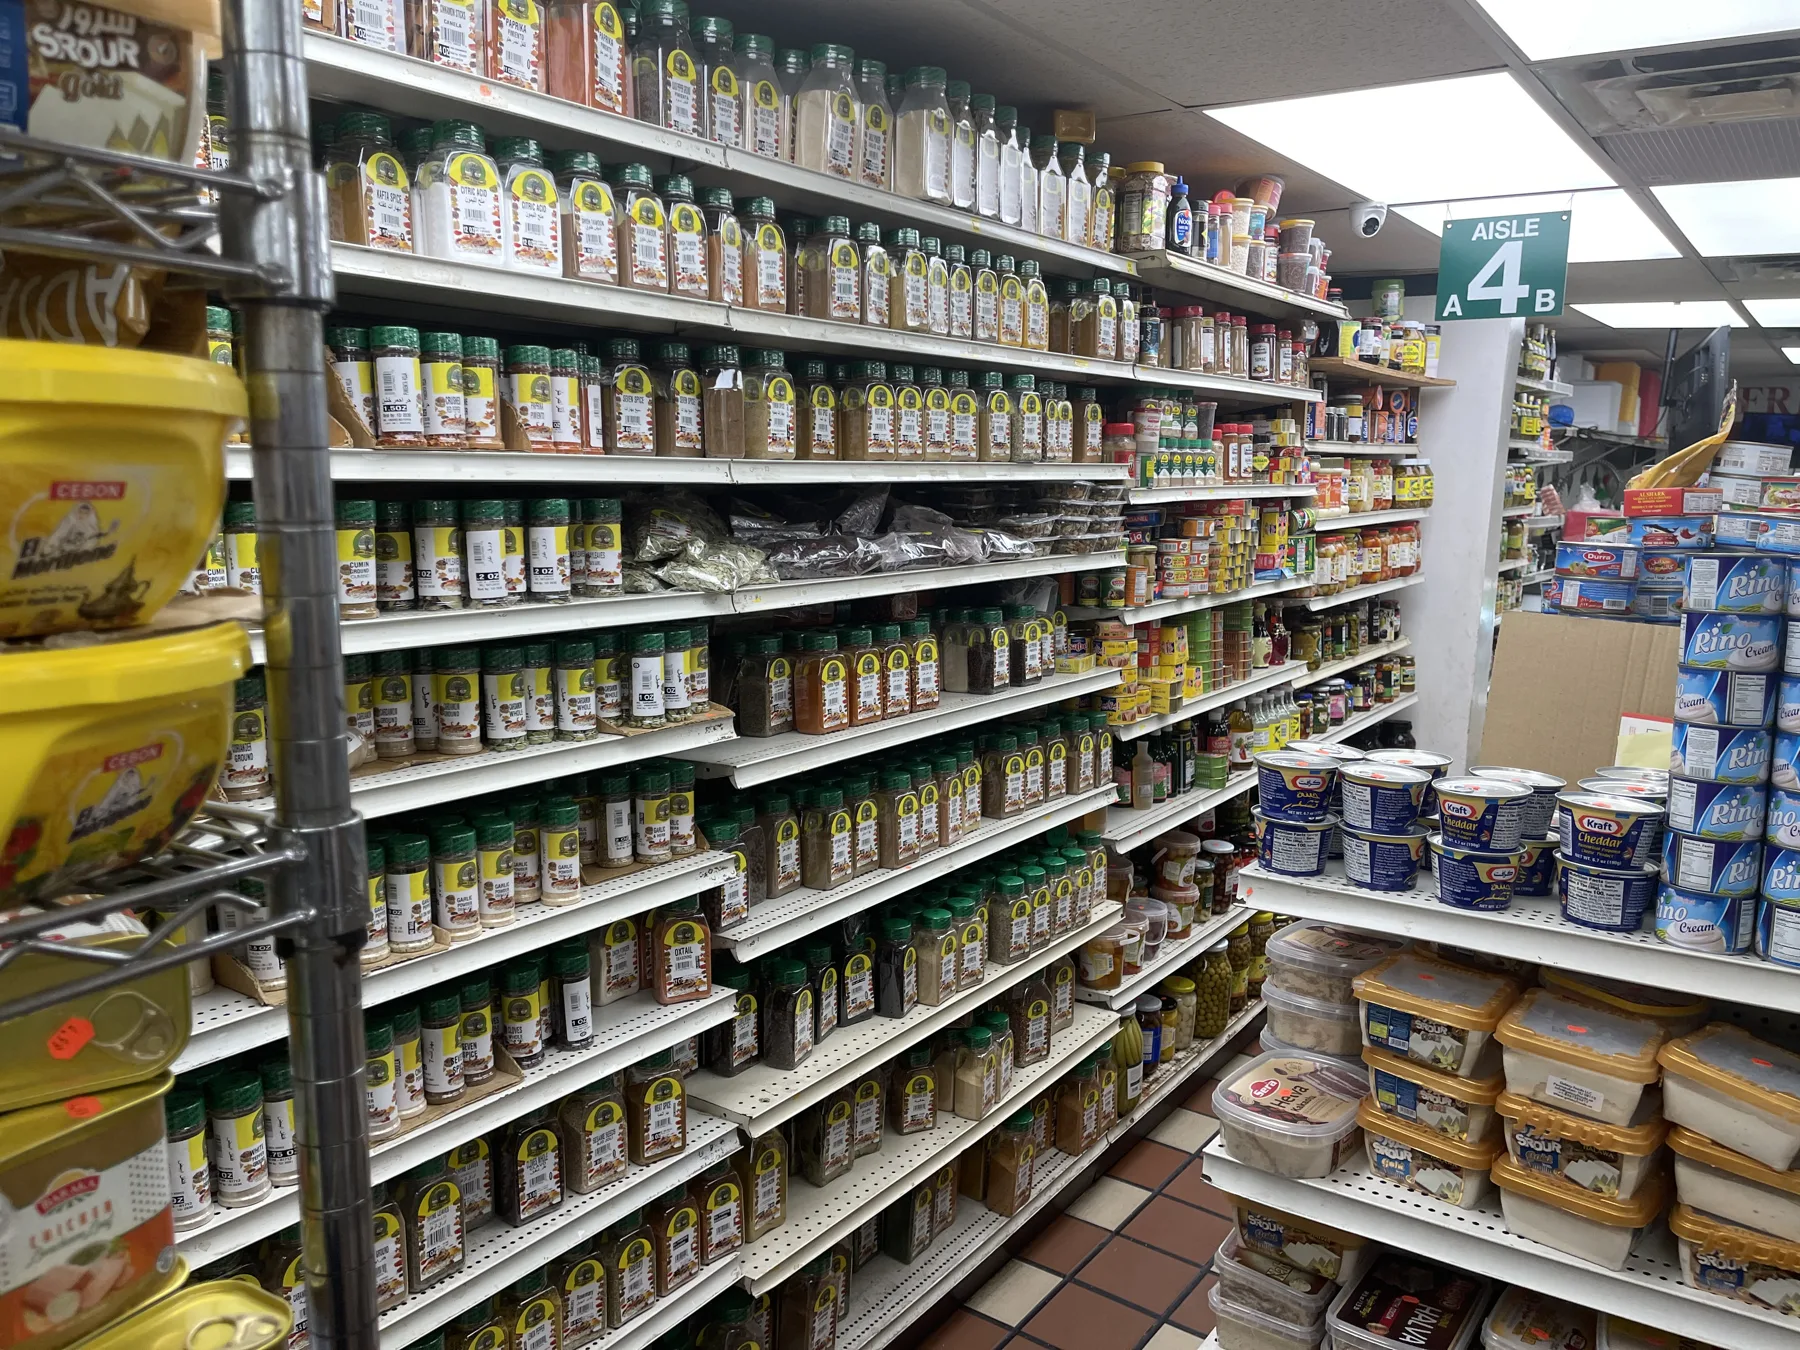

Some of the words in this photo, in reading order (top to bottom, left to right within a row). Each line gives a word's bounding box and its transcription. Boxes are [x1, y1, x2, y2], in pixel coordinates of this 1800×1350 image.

[505, 17, 527, 33] PAPRIKA
[507, 28, 525, 41] PIMIENTO
[599, 31, 614, 46] PAPRIKA
[32, 24, 140, 69] SROUR
[376, 189, 389, 202] KAFTA
[389, 192, 402, 205] SPICE
[460, 186, 474, 197] CITRIC
[475, 188, 488, 198] ACID
[521, 201, 535, 213] CITRIC
[535, 204, 547, 214] ACID
[1471, 218, 1541, 242] AISLE
[1467, 241, 1530, 315] 4
[1442, 294, 1463, 317] A
[1534, 289, 1556, 313] B
[622, 394, 633, 403] SEVEN
[633, 395, 645, 405] SPICE
[679, 394, 688, 404] SEVEN
[687, 395, 696, 405] SPICE
[56, 483, 123, 500] CEBON
[1587, 553, 1612, 561] Durra
[349, 561, 370, 569] CUMIN
[207, 568, 226, 576] CUMIN
[349, 567, 370, 575] GROUND
[422, 570, 432, 578] OZ
[487, 571, 500, 580] OZ
[541, 567, 554, 575] OZ
[207, 575, 226, 583] GROUND
[1728, 566, 1780, 598] Rino
[1694, 625, 1751, 655] Rino
[1745, 643, 1775, 659] Cream
[604, 691, 619, 699] WHOLE
[666, 687, 676, 695] OZ
[644, 693, 654, 701] OZ
[1678, 695, 1706, 710] Cream
[577, 703, 592, 711] WHOLE
[509, 709, 523, 717] WHOLE
[380, 716, 398, 724] GROUND
[106, 745, 161, 770] CEBON
[234, 753, 254, 762] GROUND
[1447, 803, 1467, 815] Kraft
[1710, 799, 1761, 825] Rino
[1443, 815, 1479, 831] Cheddar
[1586, 818, 1613, 832] Kraft
[653, 826, 666, 835] GARLIC
[1577, 832, 1623, 848] Cheddar
[513, 861, 528, 869] GARLIC
[557, 863, 573, 871] GARLIC
[1728, 860, 1760, 884] Rin
[494, 882, 511, 891] GARLIC
[494, 888, 511, 896] POWDER
[456, 895, 473, 904] GARLIC
[457, 901, 473, 909] POWDER
[1679, 922, 1715, 933] Cream
[674, 946, 694, 957] OXTAIL
[577, 1017, 587, 1026] OZ
[507, 1025, 523, 1035] CLOVES
[1415, 1020, 1448, 1035] SROUR
[462, 1042, 478, 1052] SEVEN
[462, 1051, 478, 1059] SPICE
[1252, 1079, 1278, 1098] Sera
[1421, 1090, 1453, 1104] SROUR
[662, 1101, 672, 1110] SPICE
[592, 1133, 605, 1145] SESAME
[604, 1129, 616, 1140] SEEDS
[1516, 1132, 1562, 1154] SROUR
[1372, 1142, 1413, 1161] SROUR
[538, 1154, 548, 1164] WHOLE
[221, 1171, 233, 1179] OZ
[28, 1199, 113, 1250] CHICKEN
[1247, 1214, 1284, 1233] SROUR
[1695, 1251, 1750, 1272] SROUR
[576, 1290, 594, 1300] Rosemary
[1397, 1302, 1444, 1347] HALVA
